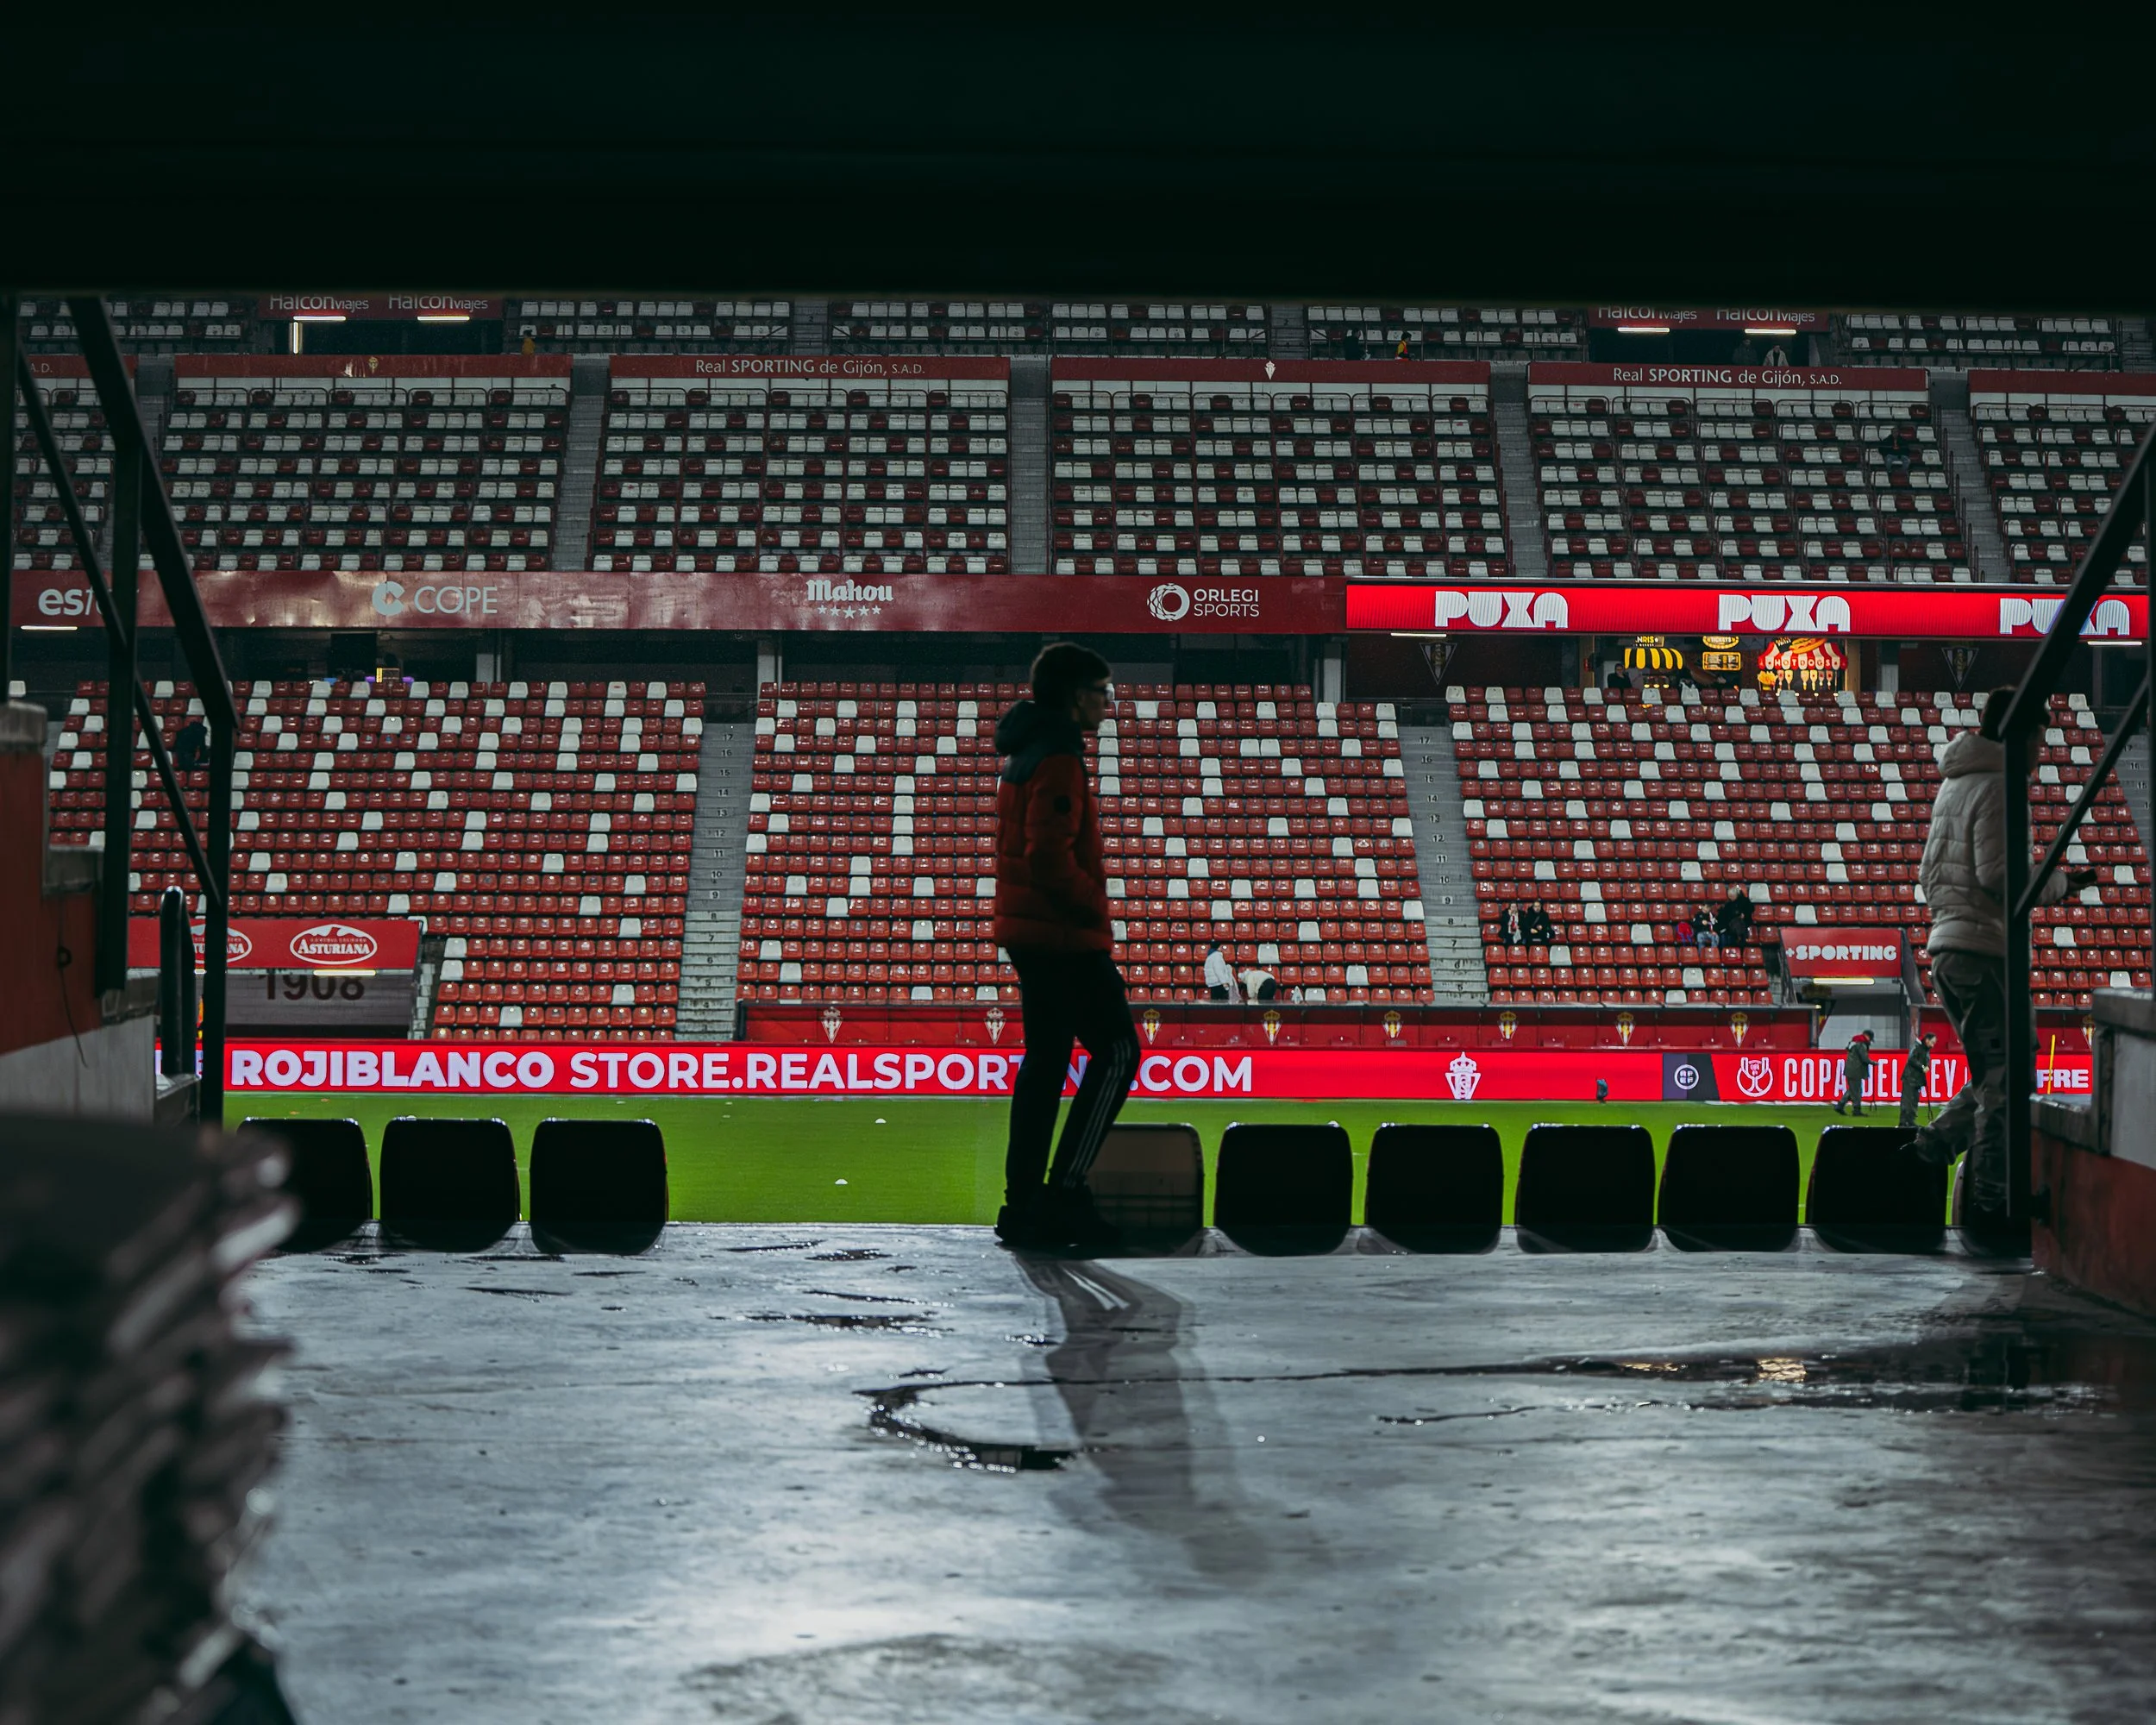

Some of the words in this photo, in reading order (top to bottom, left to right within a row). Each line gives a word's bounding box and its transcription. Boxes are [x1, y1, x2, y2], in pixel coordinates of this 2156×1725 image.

[30, 362, 53, 373] A.D.
[696, 359, 726, 373] Real
[731, 359, 815, 373] SPORTING
[819, 359, 837, 373] de
[843, 359, 887, 378] Gijón,
[892, 363, 925, 374] S.A.D.
[1614, 367, 1643, 381] Real
[1648, 368, 1732, 384] SPORTING
[1738, 369, 1757, 384] de
[1762, 369, 1805, 388] Gijón,
[1809, 373, 1842, 385] S.A.D.
[413, 586, 498, 615] COPE
[805, 579, 894, 603] Mahou
[1194, 589, 1259, 602] ORLEGI
[1194, 603, 1260, 618] SPORTS
[1434, 591, 1569, 629] PUXA
[1718, 594, 1851, 632] PUXA
[298, 938, 370, 955] ASTURIANA
[231, 1049, 555, 1088] ROJIBLANCO
[1783, 1057, 1847, 1098] COPA
[2036, 1069, 2089, 1088] FRE
